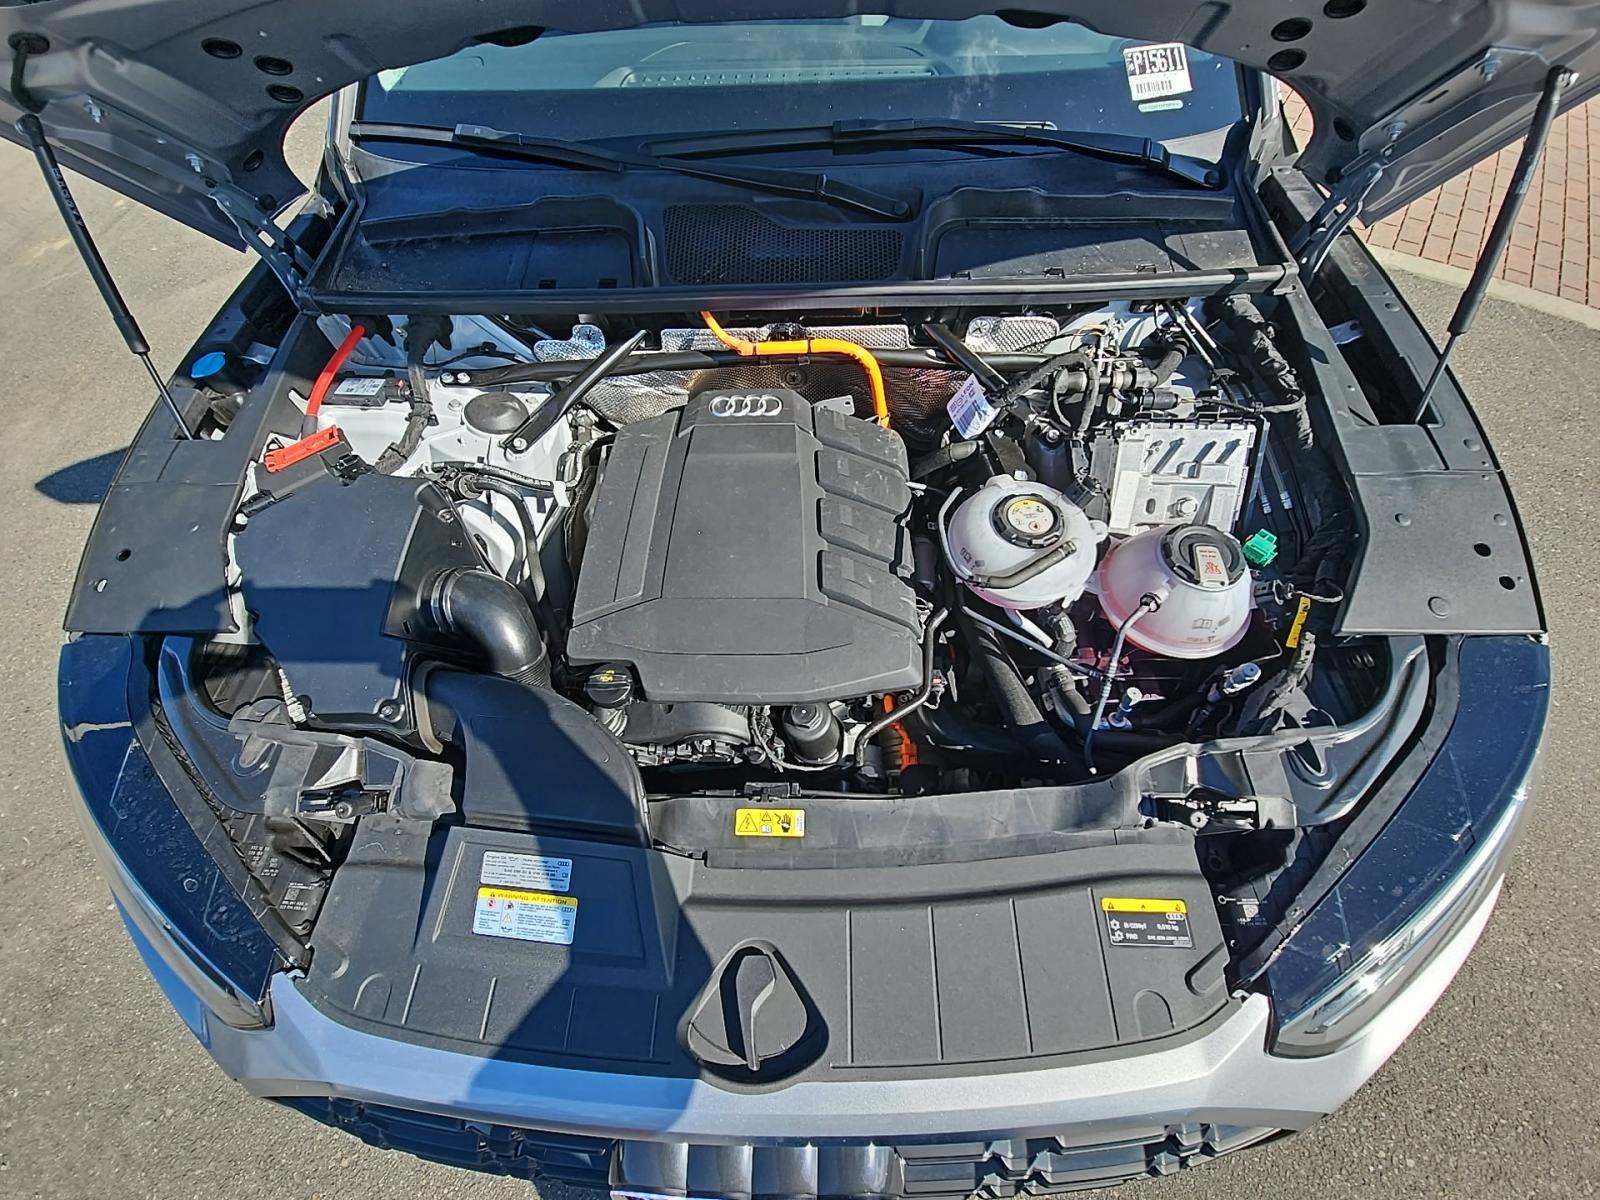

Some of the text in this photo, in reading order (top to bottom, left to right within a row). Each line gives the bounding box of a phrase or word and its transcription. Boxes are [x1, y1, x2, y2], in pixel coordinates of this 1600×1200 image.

[1132, 47, 1183, 75] P15611
[498, 892, 567, 905] WARNING ATTENTION
